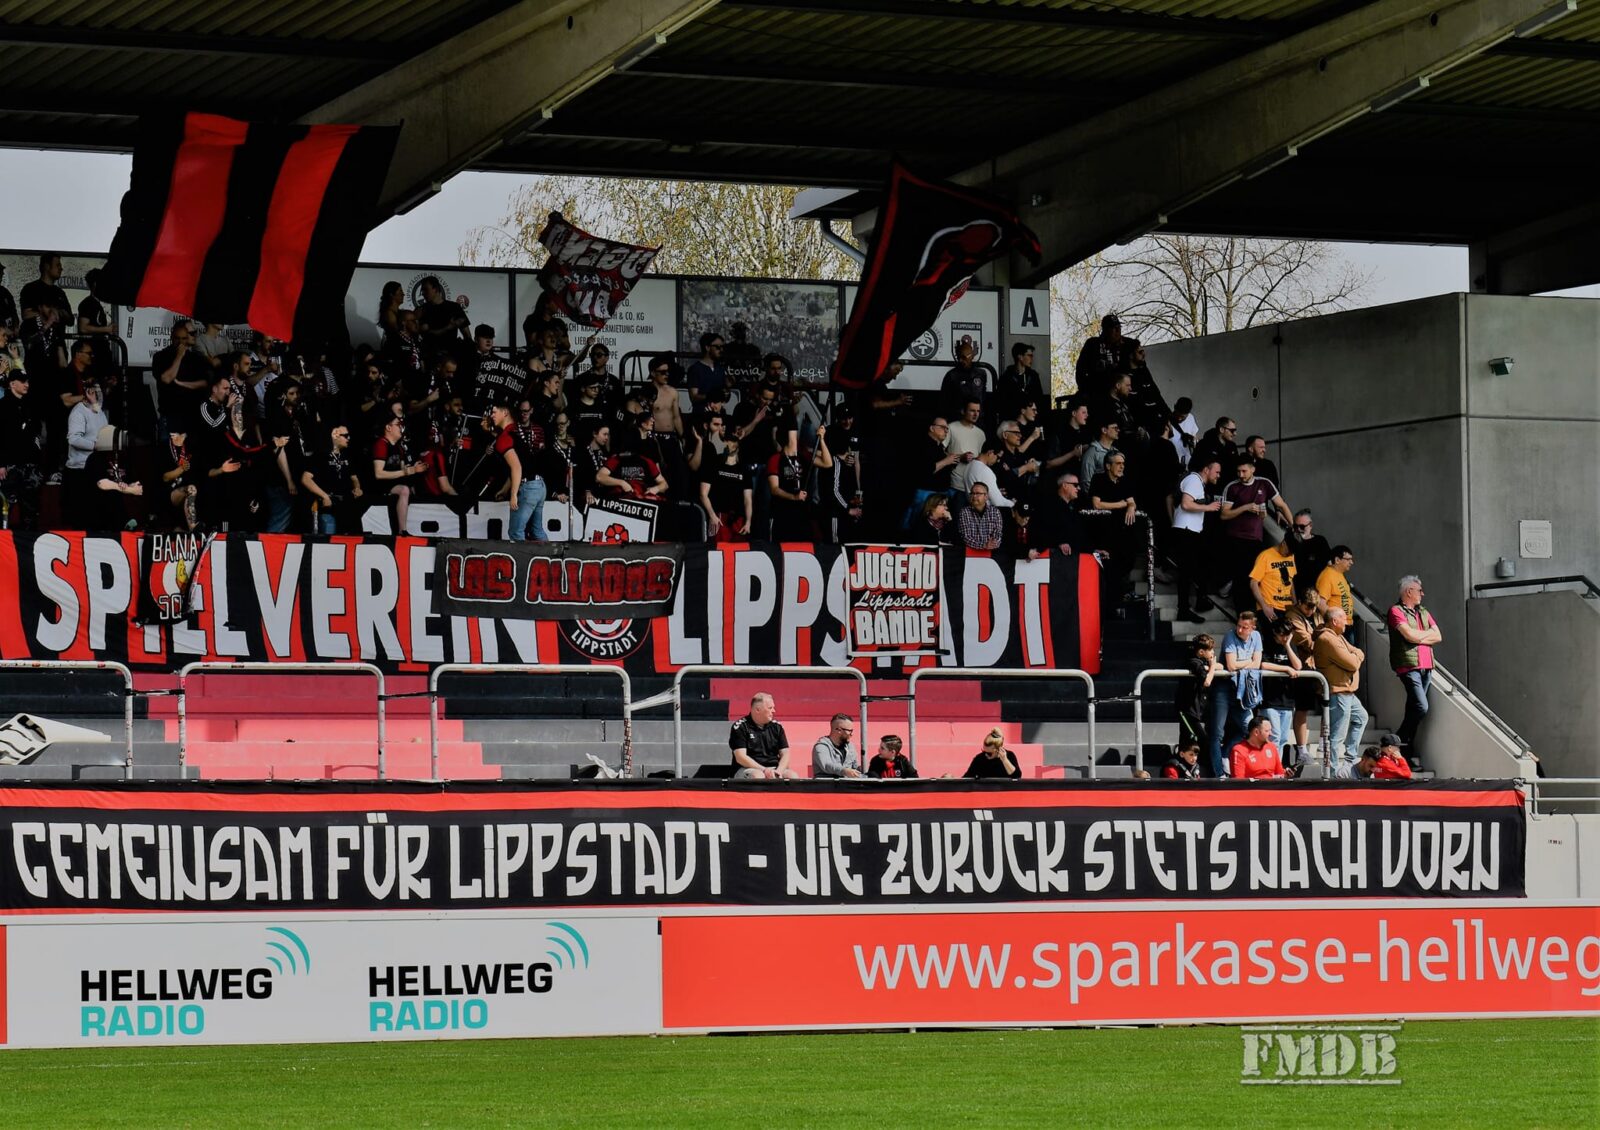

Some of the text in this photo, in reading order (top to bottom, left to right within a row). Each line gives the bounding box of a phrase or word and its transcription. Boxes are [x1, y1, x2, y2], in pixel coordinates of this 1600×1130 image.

[1021, 297, 1039, 327] A
[602, 499, 642, 516] LIPPSTADT
[642, 508, 654, 518] 08
[446, 553, 676, 605] LOS ALIADOS
[850, 552, 937, 590] JUGEND
[854, 590, 934, 611] Lippstadt
[571, 628, 638, 656] LIPPSTADT
[854, 609, 937, 645] BANDE
[12, 823, 313, 900] GEMEINSAM
[328, 813, 430, 899] FÜR
[450, 822, 729, 898] LIPPSTADT
[785, 823, 863, 896] NIE
[879, 810, 1068, 894] ZURÜCK
[1084, 820, 1237, 891] STETS
[1249, 820, 1367, 890] NACH
[1382, 820, 1500, 891] VORN
[853, 918, 1600, 1004] www.sparkasse-hellweg
[81, 968, 272, 1001] HELLWEG
[369, 963, 552, 997] HELLWEG
[81, 1004, 204, 1037] RADIO
[369, 998, 488, 1032] RADIO
